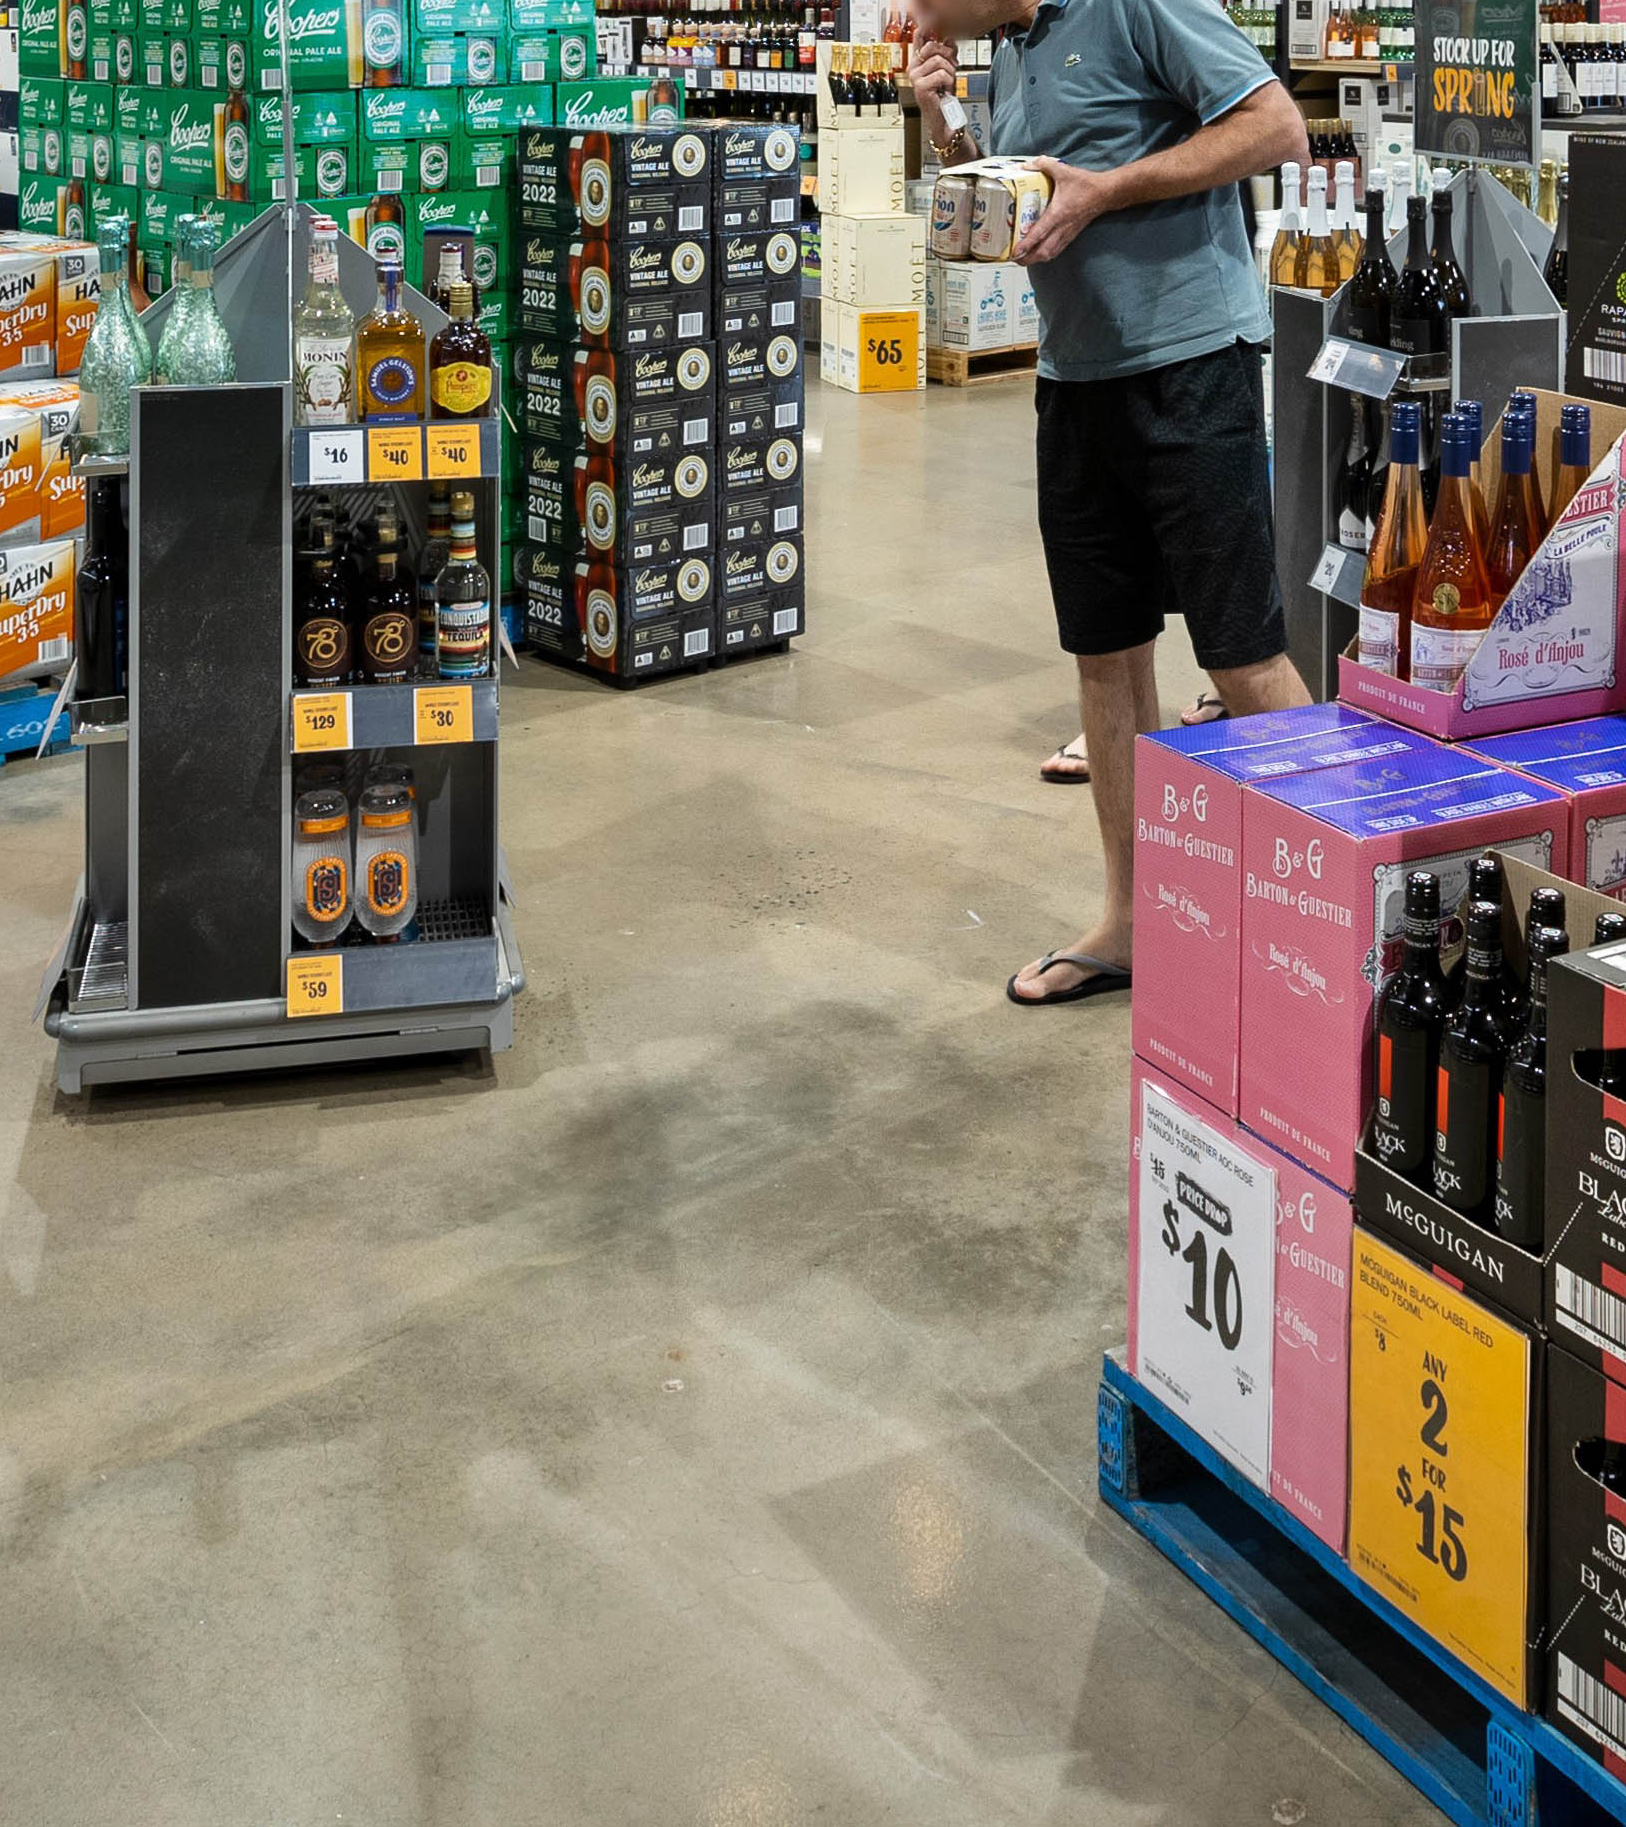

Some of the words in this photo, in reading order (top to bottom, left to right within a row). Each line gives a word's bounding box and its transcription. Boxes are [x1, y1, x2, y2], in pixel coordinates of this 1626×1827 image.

[1434, 37, 1470, 64] STOCK
[1472, 39, 1489, 65] UP
[1492, 40, 1515, 67] FOR
[523, 165, 542, 174] VINTAGE
[545, 166, 556, 175] ALE
[523, 184, 556, 204] 2022
[304, 352, 348, 362] MONIN
[867, 338, 902, 365] $65
[325, 447, 347, 463] $16
[383, 450, 408, 465] $40
[441, 447, 467, 462] $40
[1554, 547, 1562, 556] LA
[1564, 537, 1585, 554] BELLE
[1587, 525, 1607, 541] POULE
[446, 632, 484, 641] TEQUILA
[1499, 646, 1528, 669] Rosé
[1536, 641, 1584, 664] d'Anjou
[305, 716, 335, 730] $129
[431, 710, 453, 727] $30
[300, 982, 327, 999] $59
[1147, 1103, 1173, 1132] BARTON
[1175, 1123, 1181, 1134] &
[1182, 1127, 1217, 1160] GUESTIER
[1219, 1154, 1234, 1173] AOC
[1175, 1140, 1202, 1164] 750ML
[1179, 1183, 1203, 1212] PRICE
[1205, 1198, 1227, 1227] DROP
[1386, 1192, 1503, 1283] McGUIGAN
[1601, 1232, 1625, 1253] RED
[1163, 1199, 1243, 1351] $10
[1360, 1270, 1389, 1297] BLEND
[1392, 1291, 1423, 1321] 750ML
[1409, 1285, 1440, 1312] BLACK
[1442, 1306, 1471, 1334] LABEL
[1473, 1327, 1493, 1348] RED
[1375, 1329, 1386, 1352] $8
[1422, 1350, 1447, 1381] ANY
[1420, 1379, 1448, 1457] 2
[1422, 1458, 1445, 1493] FOR
[1397, 1465, 1468, 1582] $15
